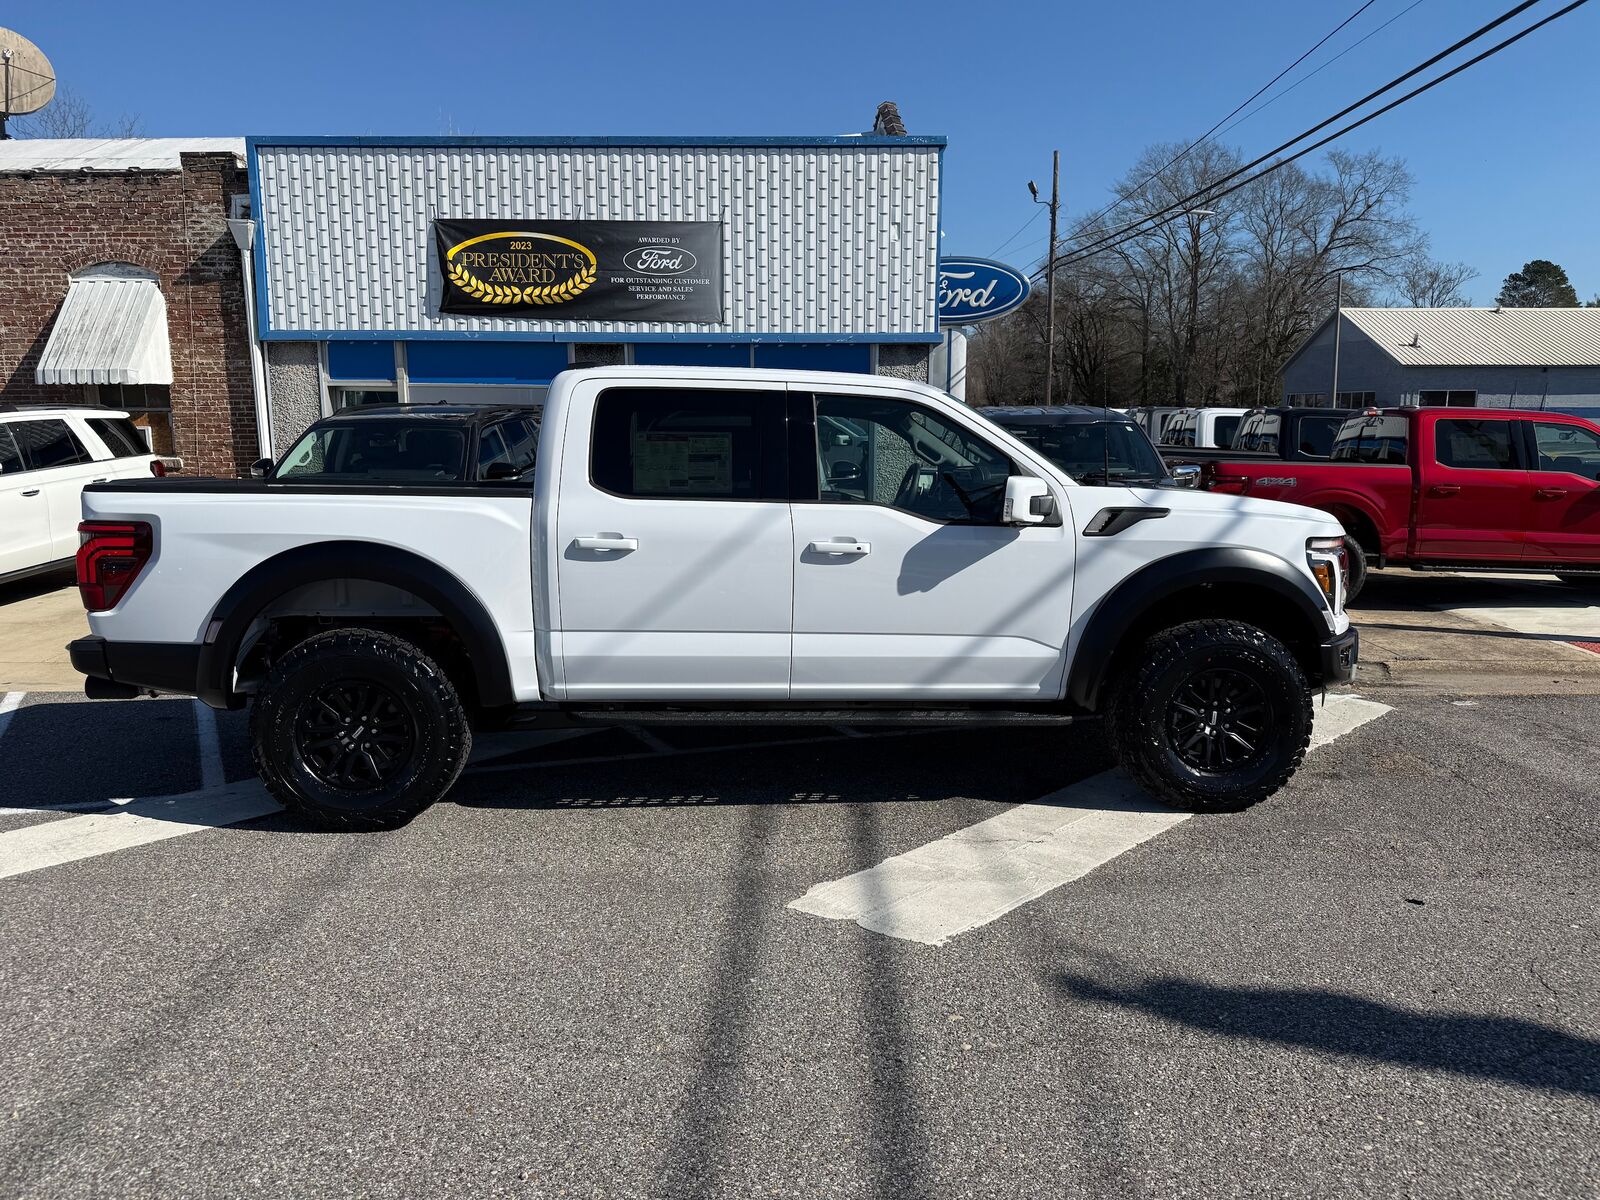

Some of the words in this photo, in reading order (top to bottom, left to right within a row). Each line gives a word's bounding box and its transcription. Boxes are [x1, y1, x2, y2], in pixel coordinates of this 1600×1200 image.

[510, 241, 532, 250] 2023
[461, 252, 584, 269] PRESIDENT'S
[637, 249, 683, 269] Ford
[488, 267, 556, 283] AWARD
